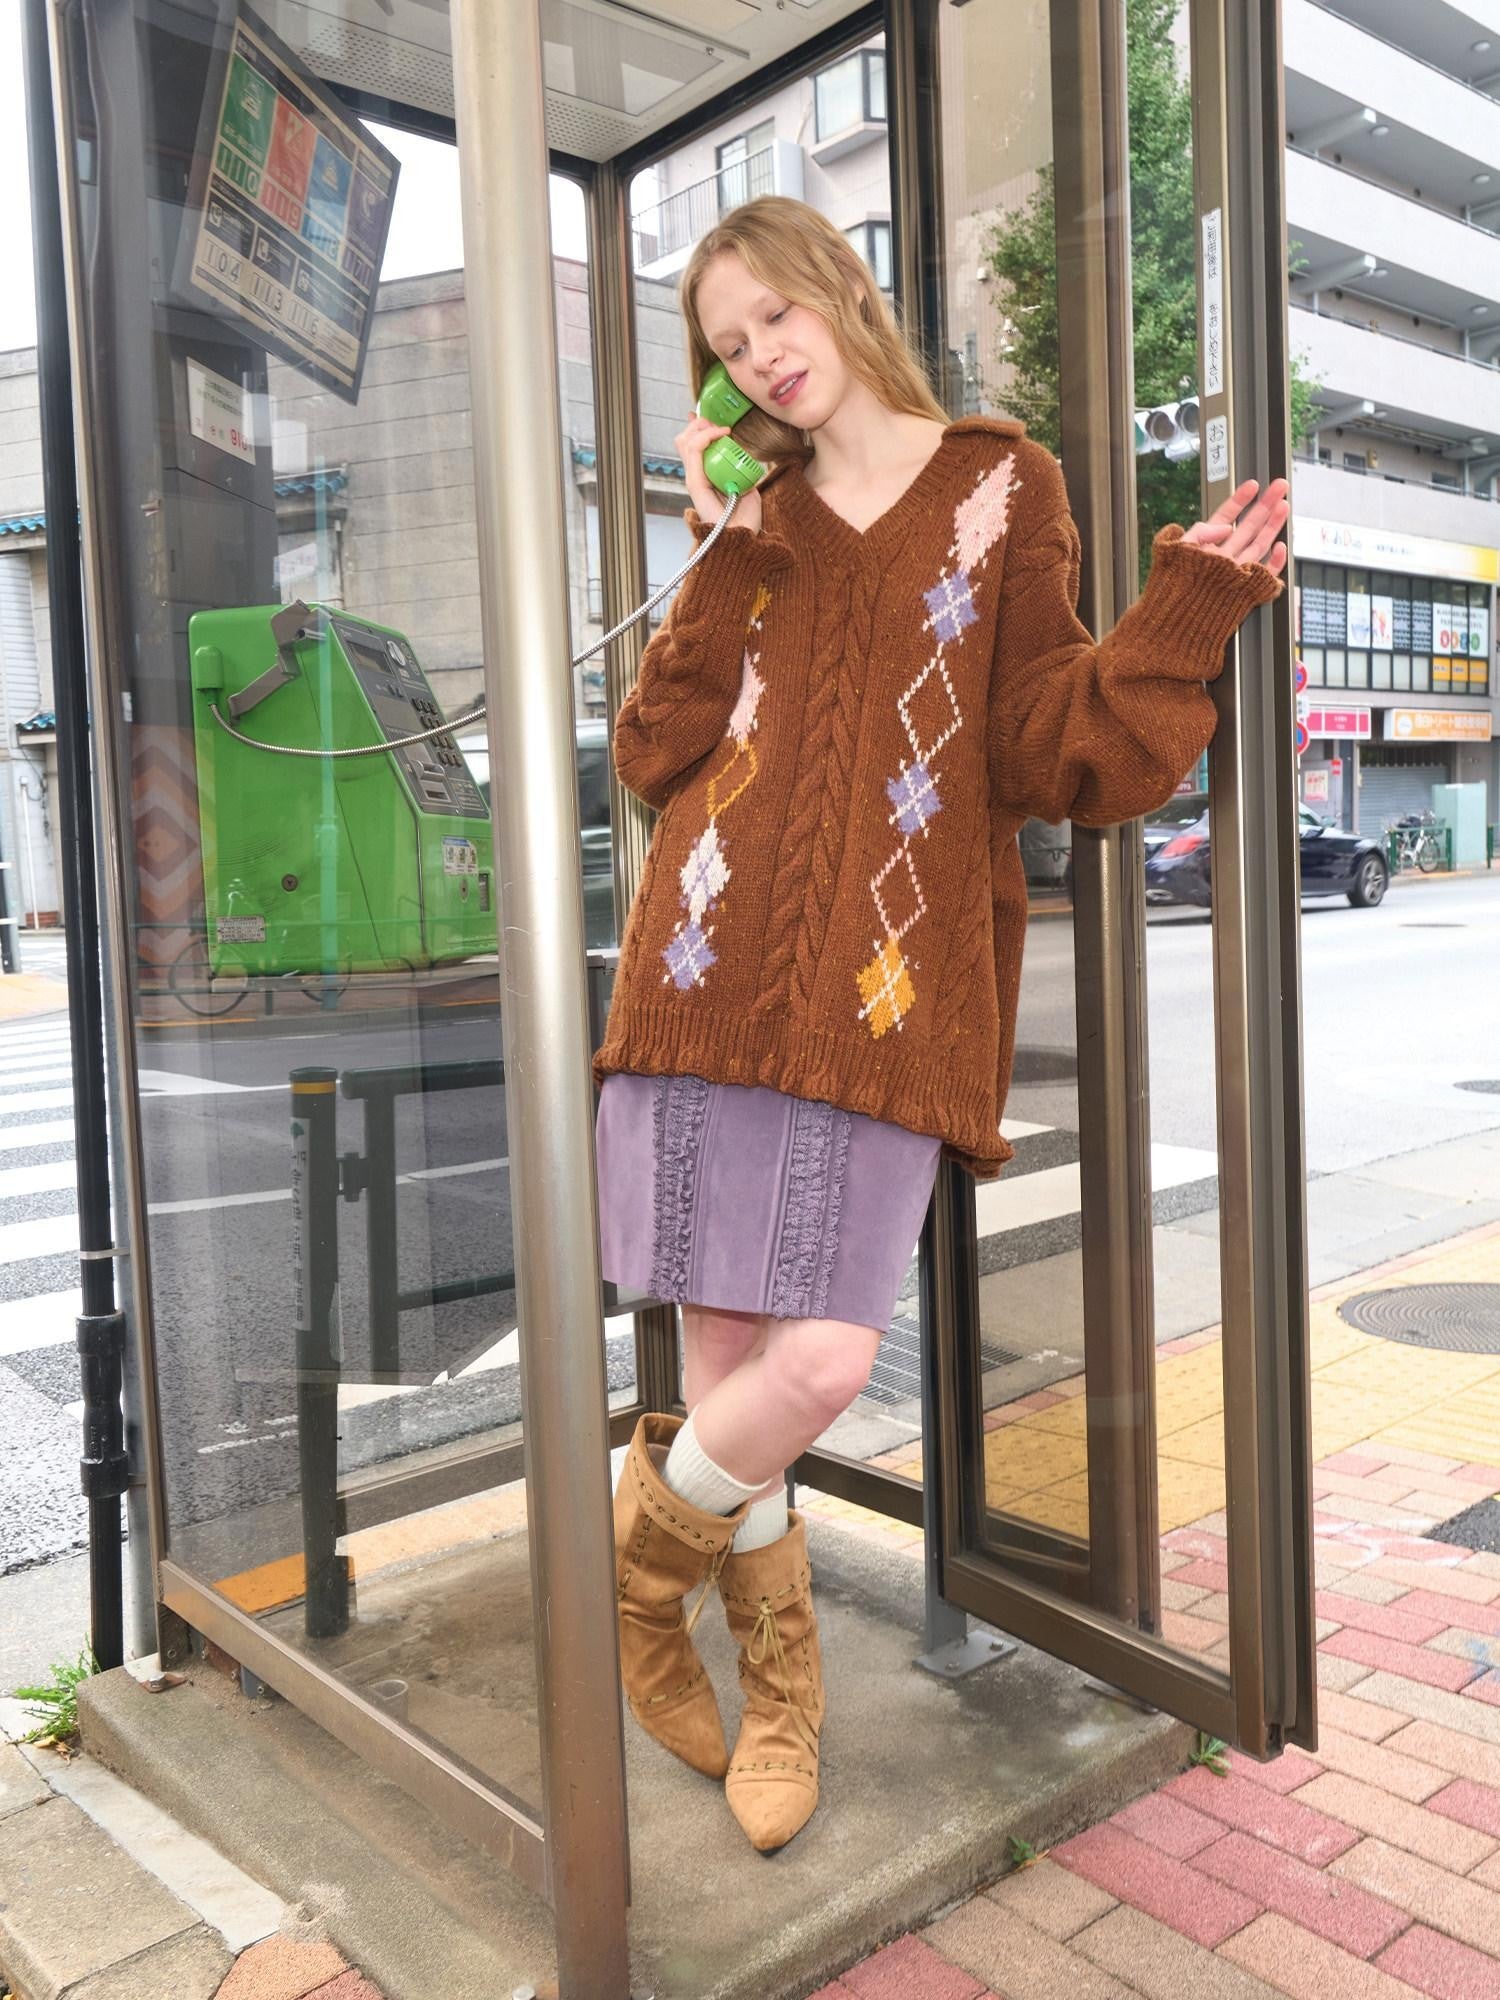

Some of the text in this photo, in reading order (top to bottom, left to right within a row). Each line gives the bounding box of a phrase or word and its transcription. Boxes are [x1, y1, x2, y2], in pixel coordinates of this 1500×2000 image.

[218, 146, 258, 194] 110
[265, 183, 300, 230] 119
[207, 243, 241, 282] 104
[254, 276, 283, 311] 113
[290, 301, 320, 335] 116
